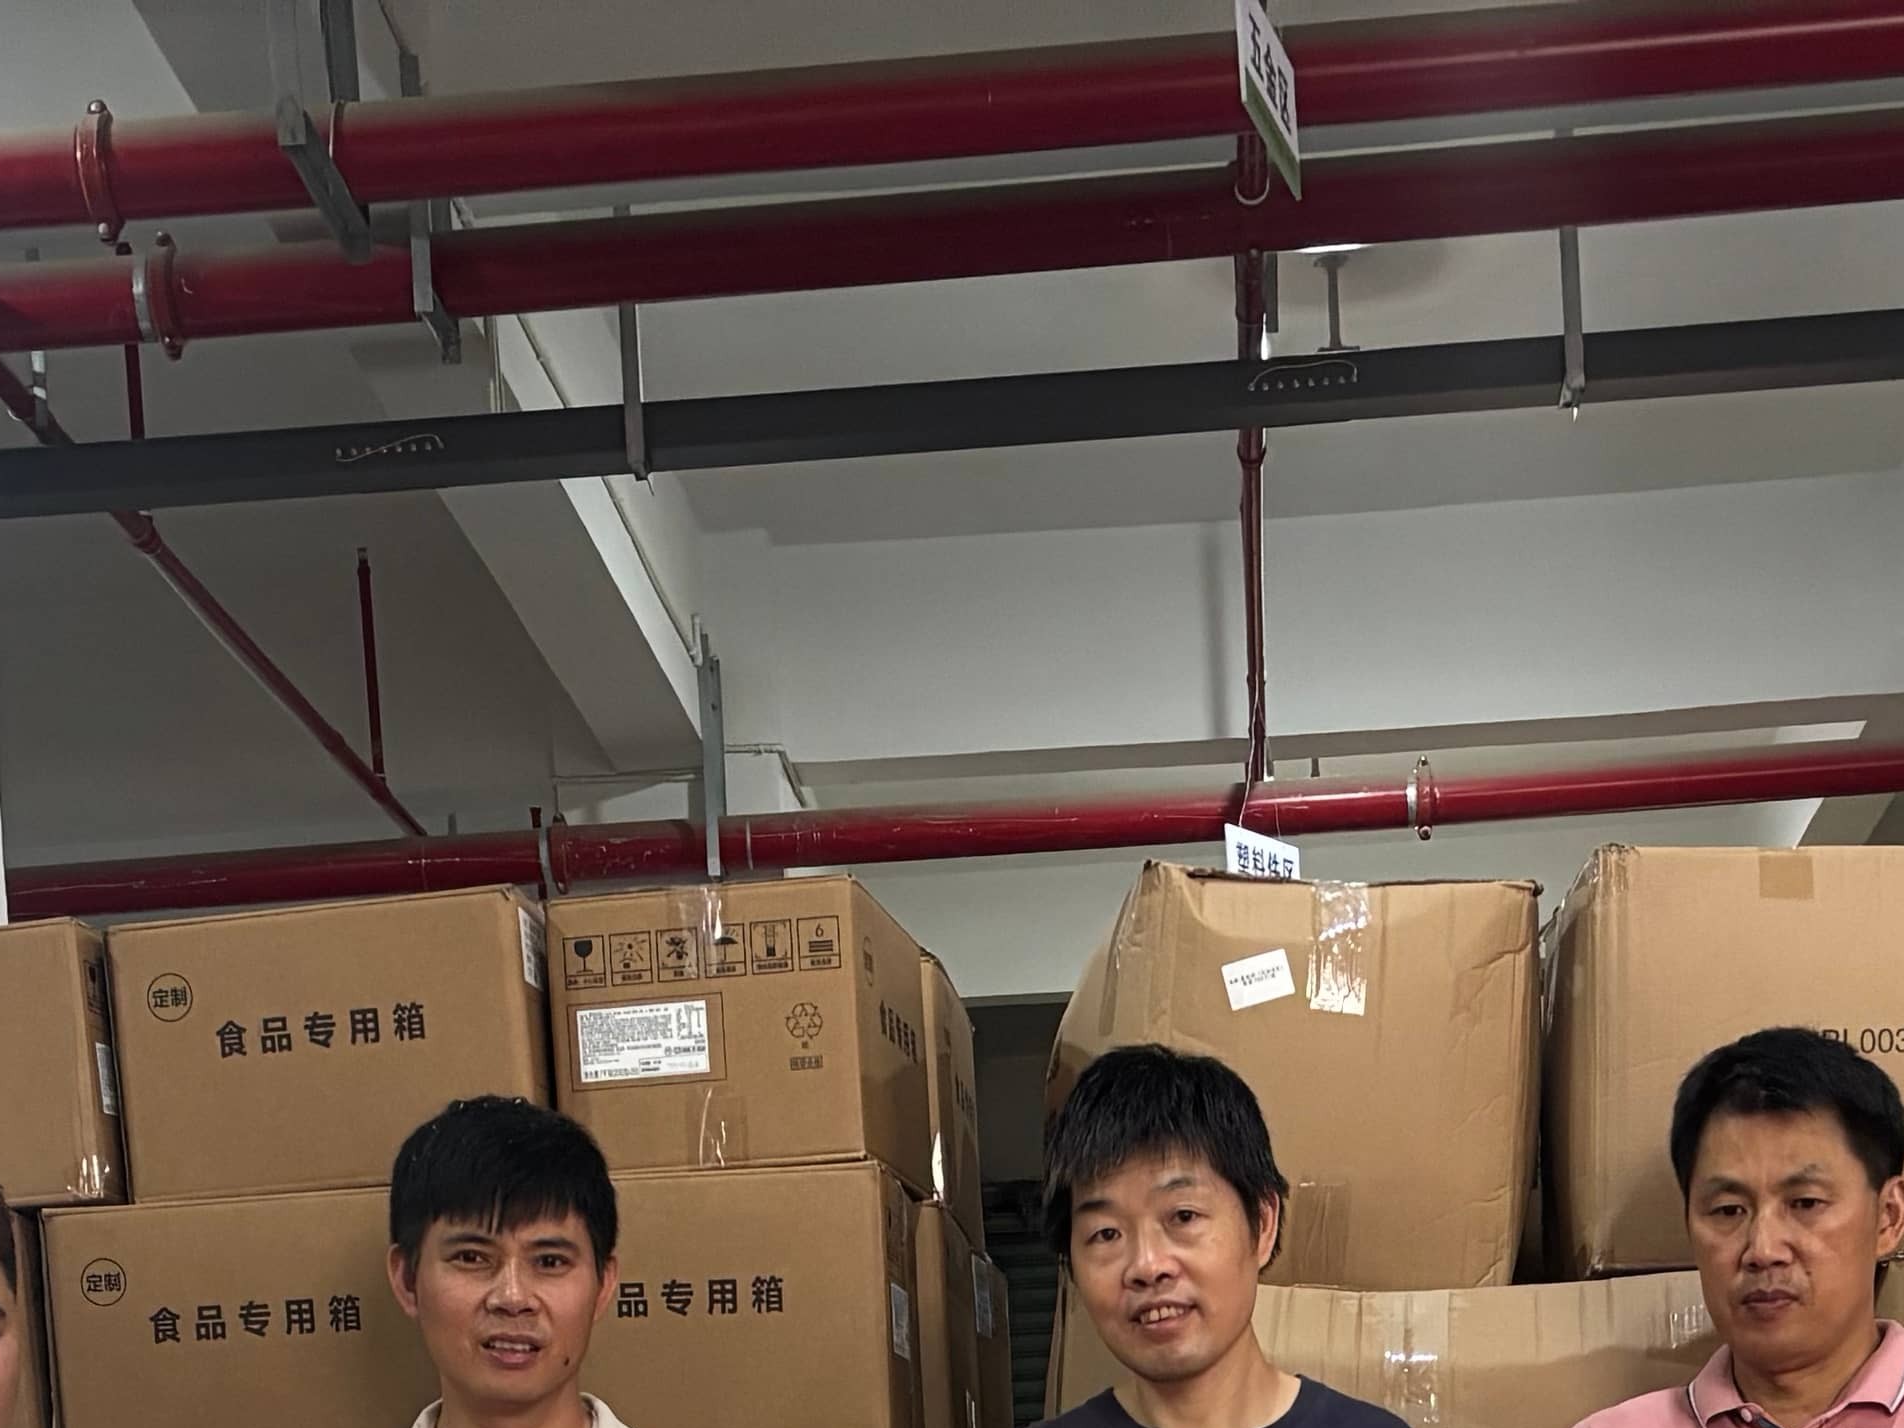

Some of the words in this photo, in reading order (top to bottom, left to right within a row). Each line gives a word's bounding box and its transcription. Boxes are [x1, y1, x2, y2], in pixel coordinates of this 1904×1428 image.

[152, 986, 188, 1009] 定制
[215, 1003, 427, 1059] 食品专用箱
[85, 1271, 122, 1294] 定制
[150, 1294, 362, 1344] 食品专用箱
